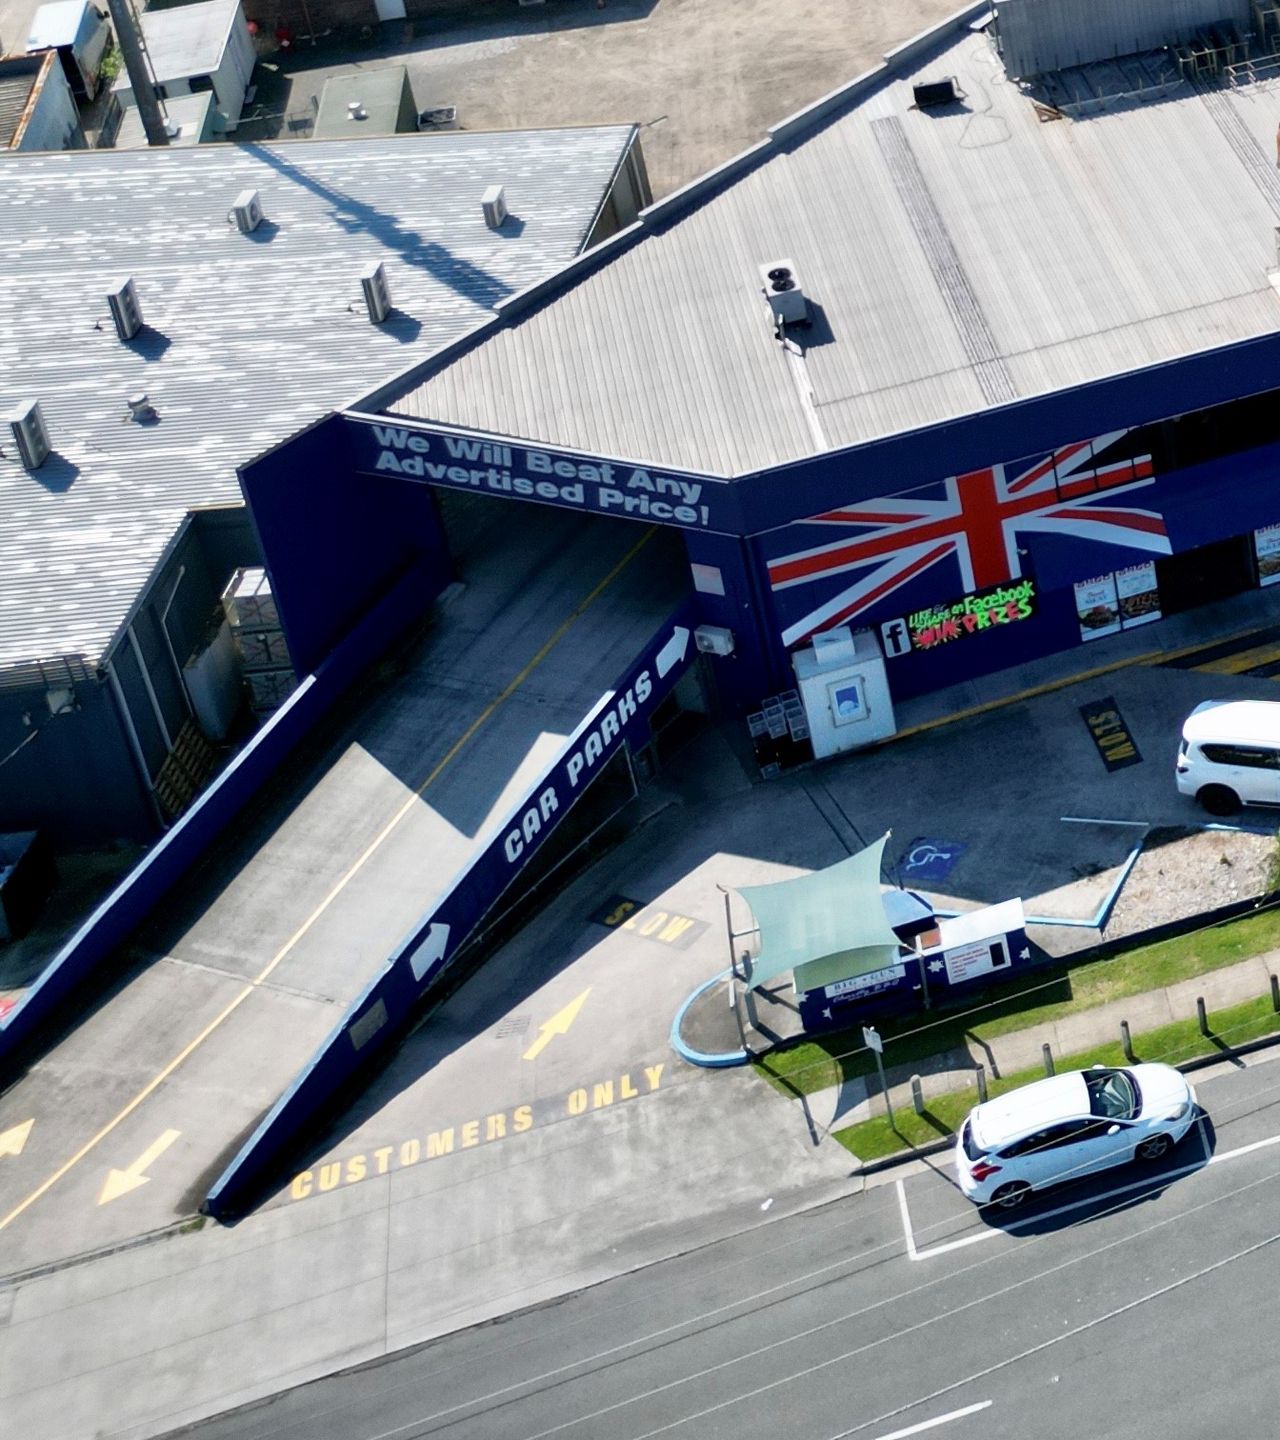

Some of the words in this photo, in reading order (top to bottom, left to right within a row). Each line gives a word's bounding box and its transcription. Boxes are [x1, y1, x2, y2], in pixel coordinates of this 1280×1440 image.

[371, 424, 431, 454] We
[442, 436, 513, 469] Will
[524, 449, 617, 486] Beat
[627, 468, 703, 505] Any
[374, 449, 586, 504] Advertised
[599, 486, 711, 527] Price!
[961, 597, 1034, 634] PRIZES
[963, 580, 1036, 615] Facebook
[1088, 710, 1137, 762] SLOW
[503, 779, 559, 863] CAR
[567, 670, 652, 788] PARKS
[605, 899, 695, 944] SLOW
[833, 976, 859, 992] BIG
[869, 967, 897, 983] GUN
[290, 1105, 534, 1200] CUSTOMERS
[568, 1064, 665, 1116] ONLY
